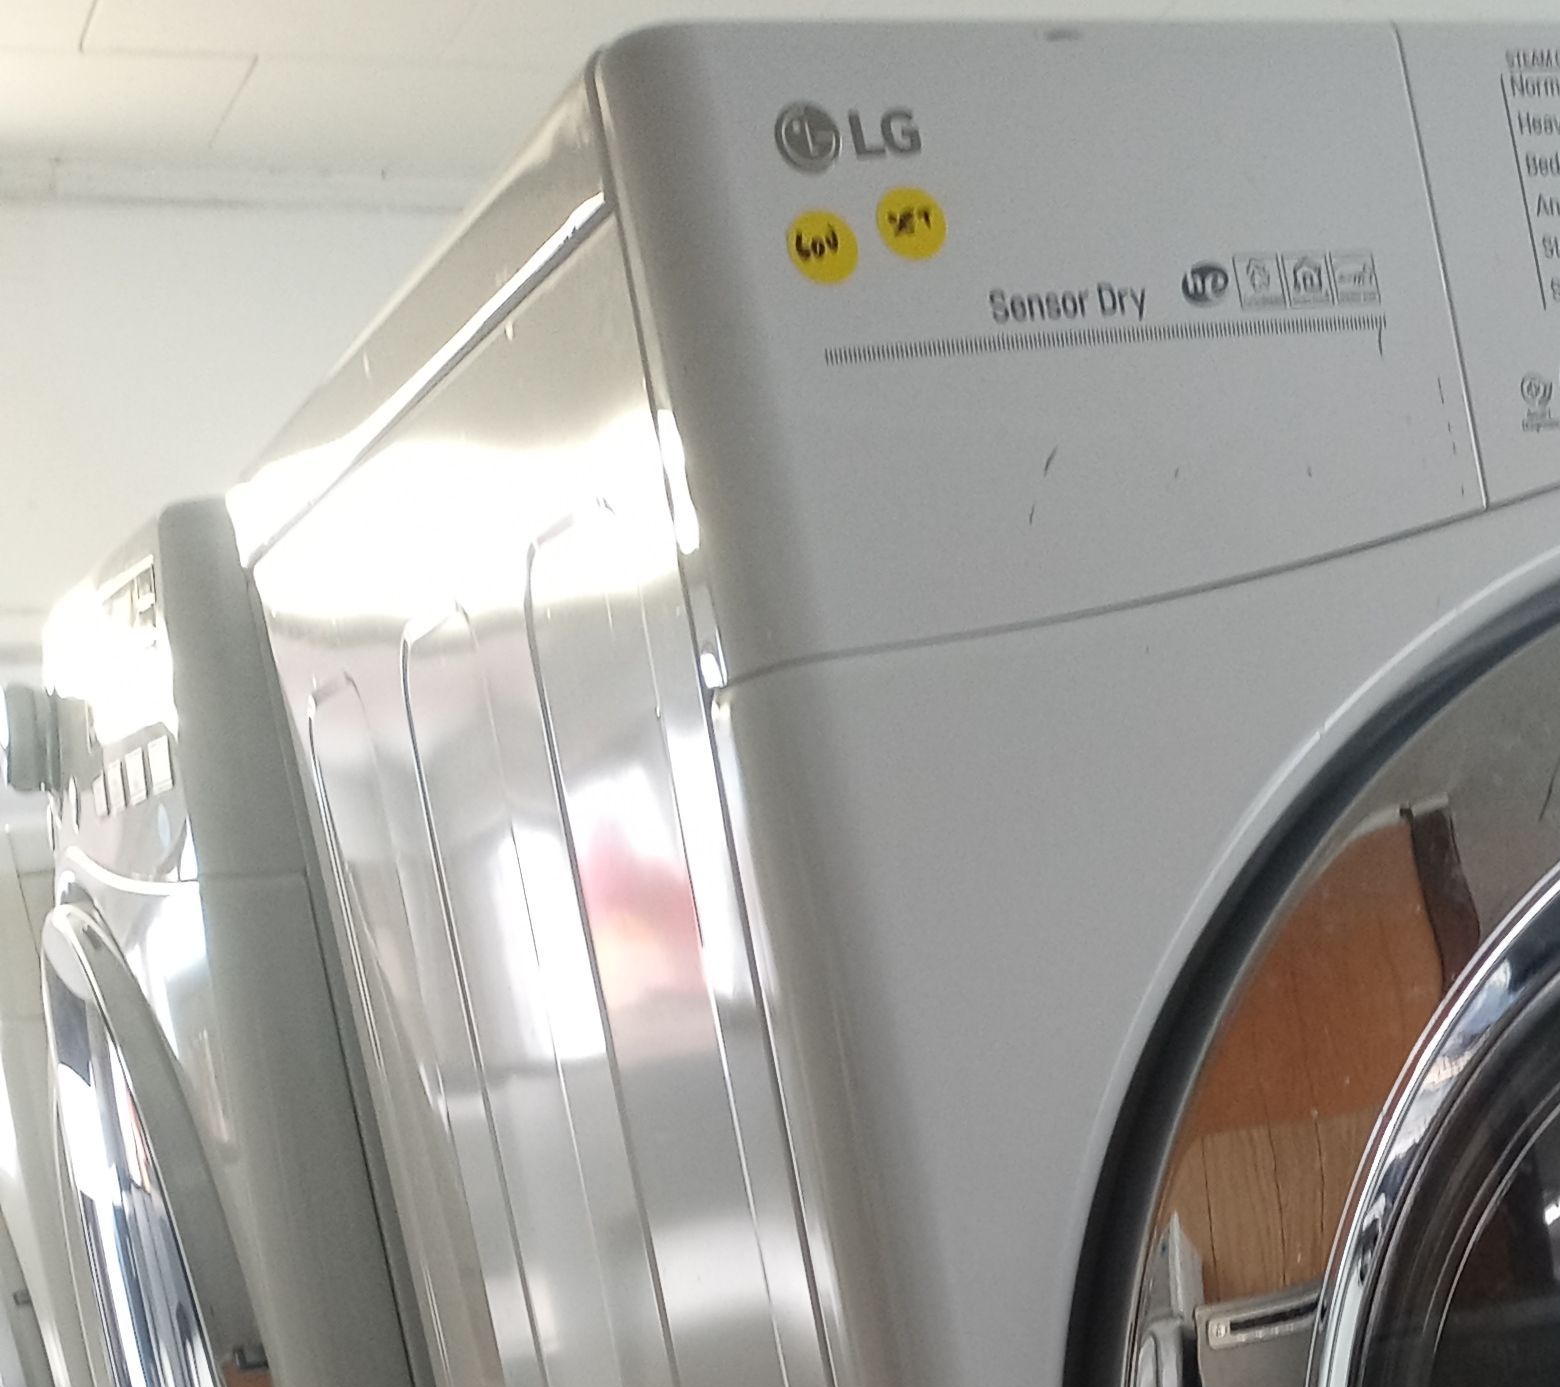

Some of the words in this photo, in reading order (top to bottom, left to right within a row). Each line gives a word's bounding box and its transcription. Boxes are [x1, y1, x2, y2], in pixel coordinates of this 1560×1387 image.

[848, 107, 922, 160] LG
[989, 286, 1089, 325] Sensor
[1098, 281, 1146, 322] Dry
